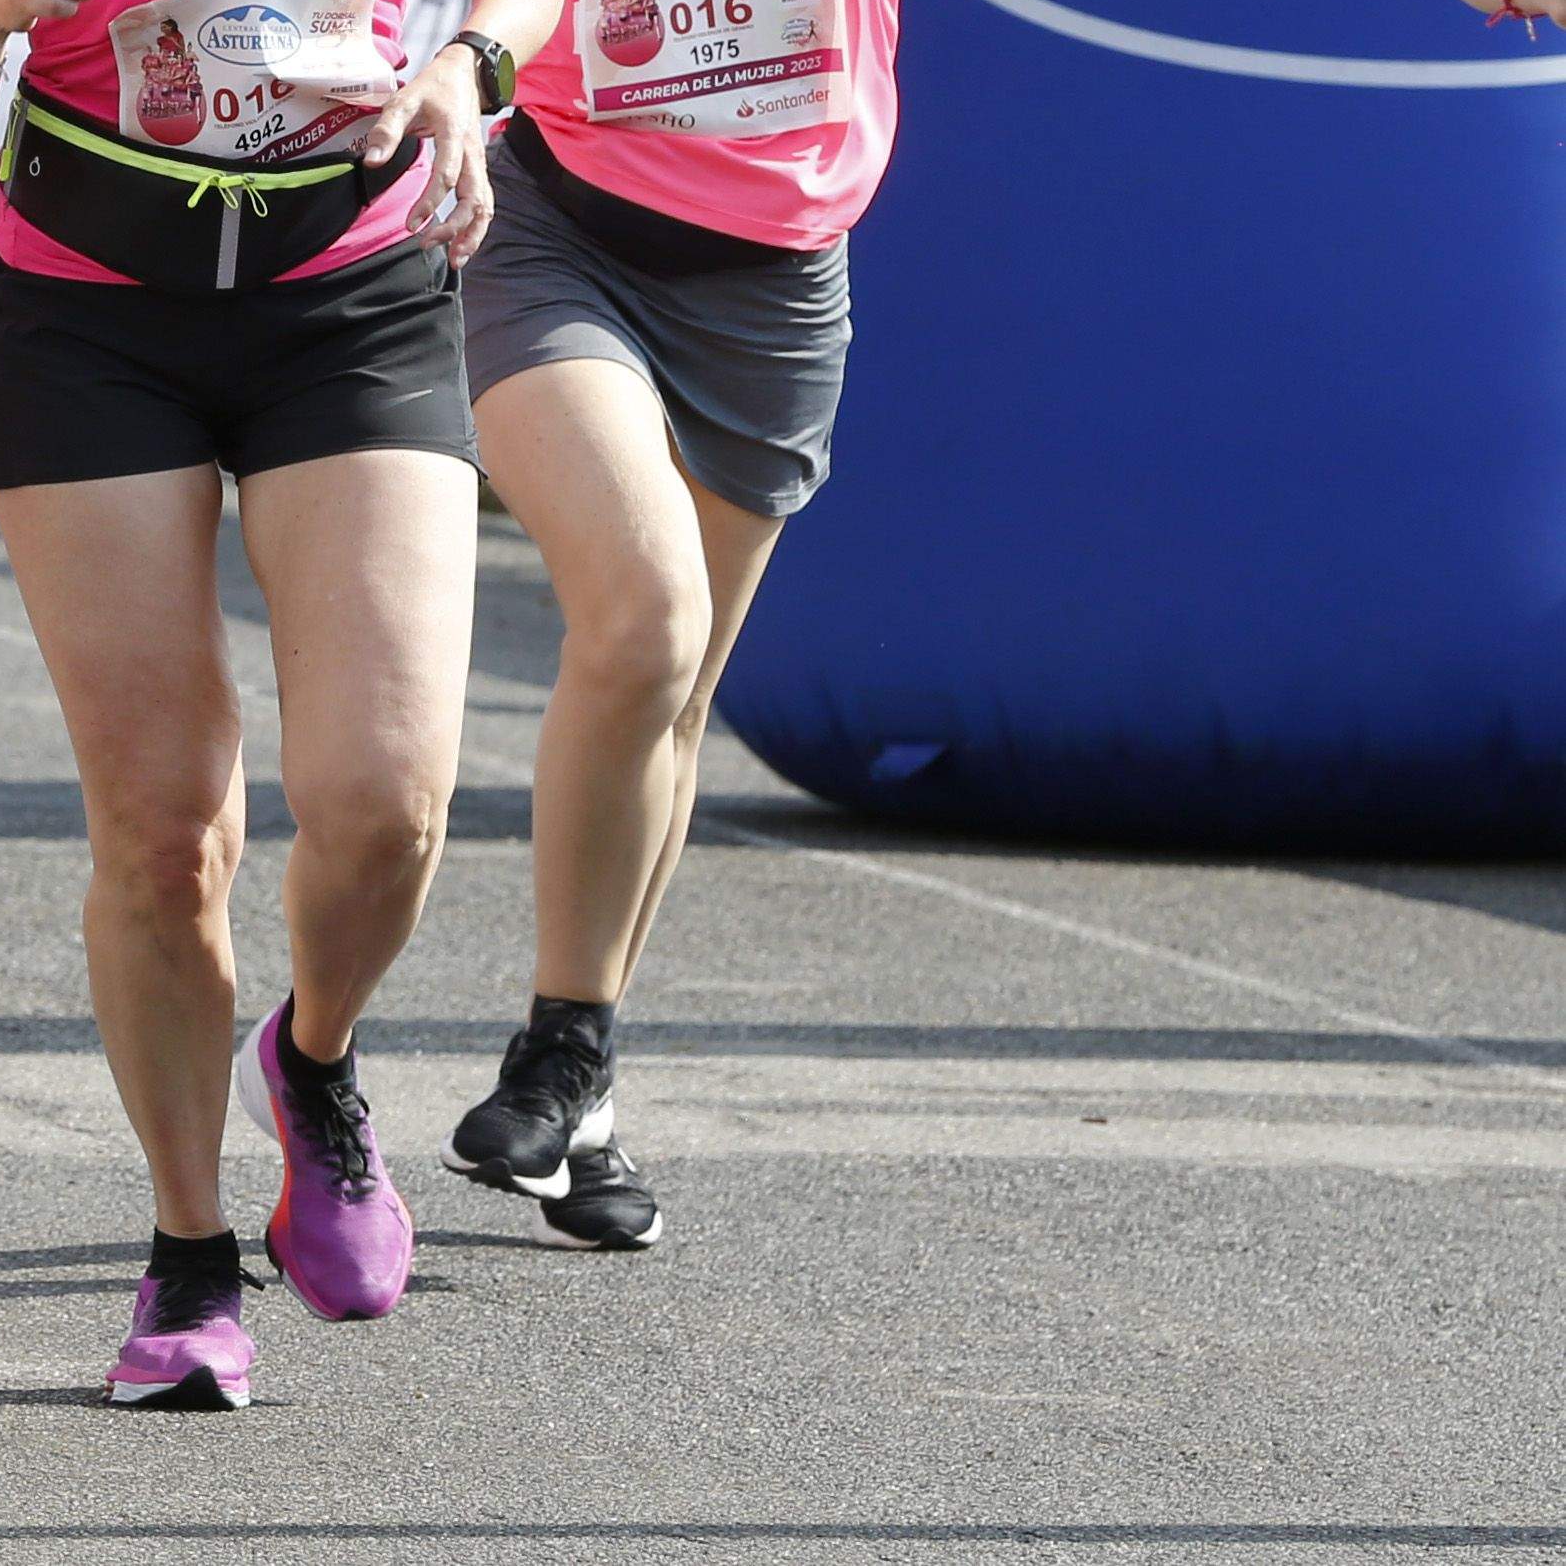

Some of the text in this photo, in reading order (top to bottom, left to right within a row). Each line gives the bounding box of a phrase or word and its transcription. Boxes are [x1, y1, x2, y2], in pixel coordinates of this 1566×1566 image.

[690, 39, 740, 65] 1975
[621, 55, 822, 104] CARRERA DE LA MUJER 2023
[756, 88, 831, 115] Santander
[235, 113, 286, 152] 4942
[281, 124, 326, 155] MUJER
